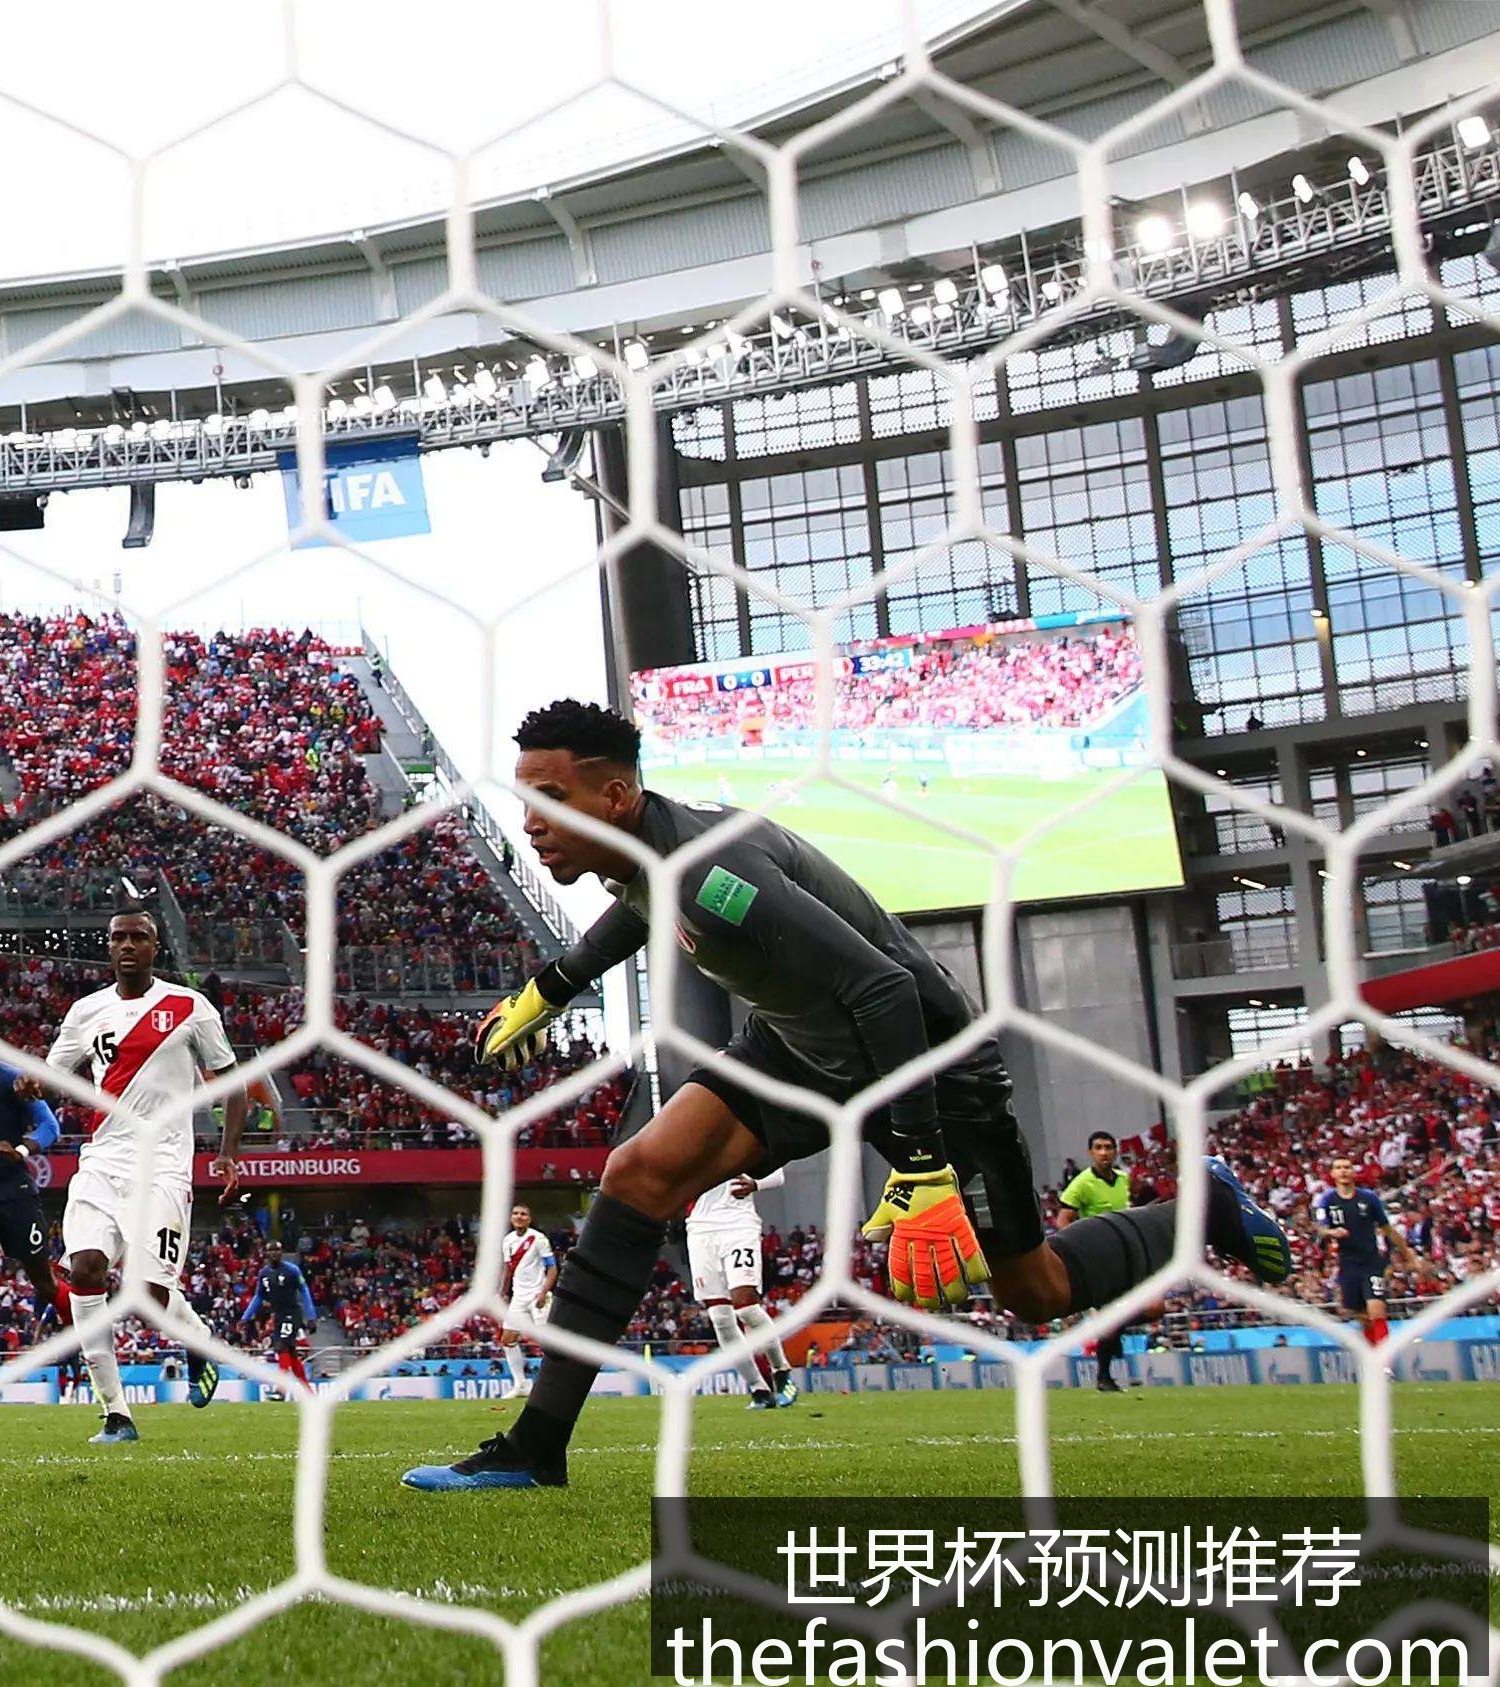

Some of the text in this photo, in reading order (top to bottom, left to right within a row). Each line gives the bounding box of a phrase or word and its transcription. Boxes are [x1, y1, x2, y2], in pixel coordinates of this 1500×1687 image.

[322, 471, 406, 513] IFA
[92, 1031, 117, 1065] 15
[208, 1158, 361, 1178] EATERINBURG
[29, 1223, 43, 1246] 6
[156, 1226, 181, 1265] 15
[731, 1247, 755, 1268] 23
